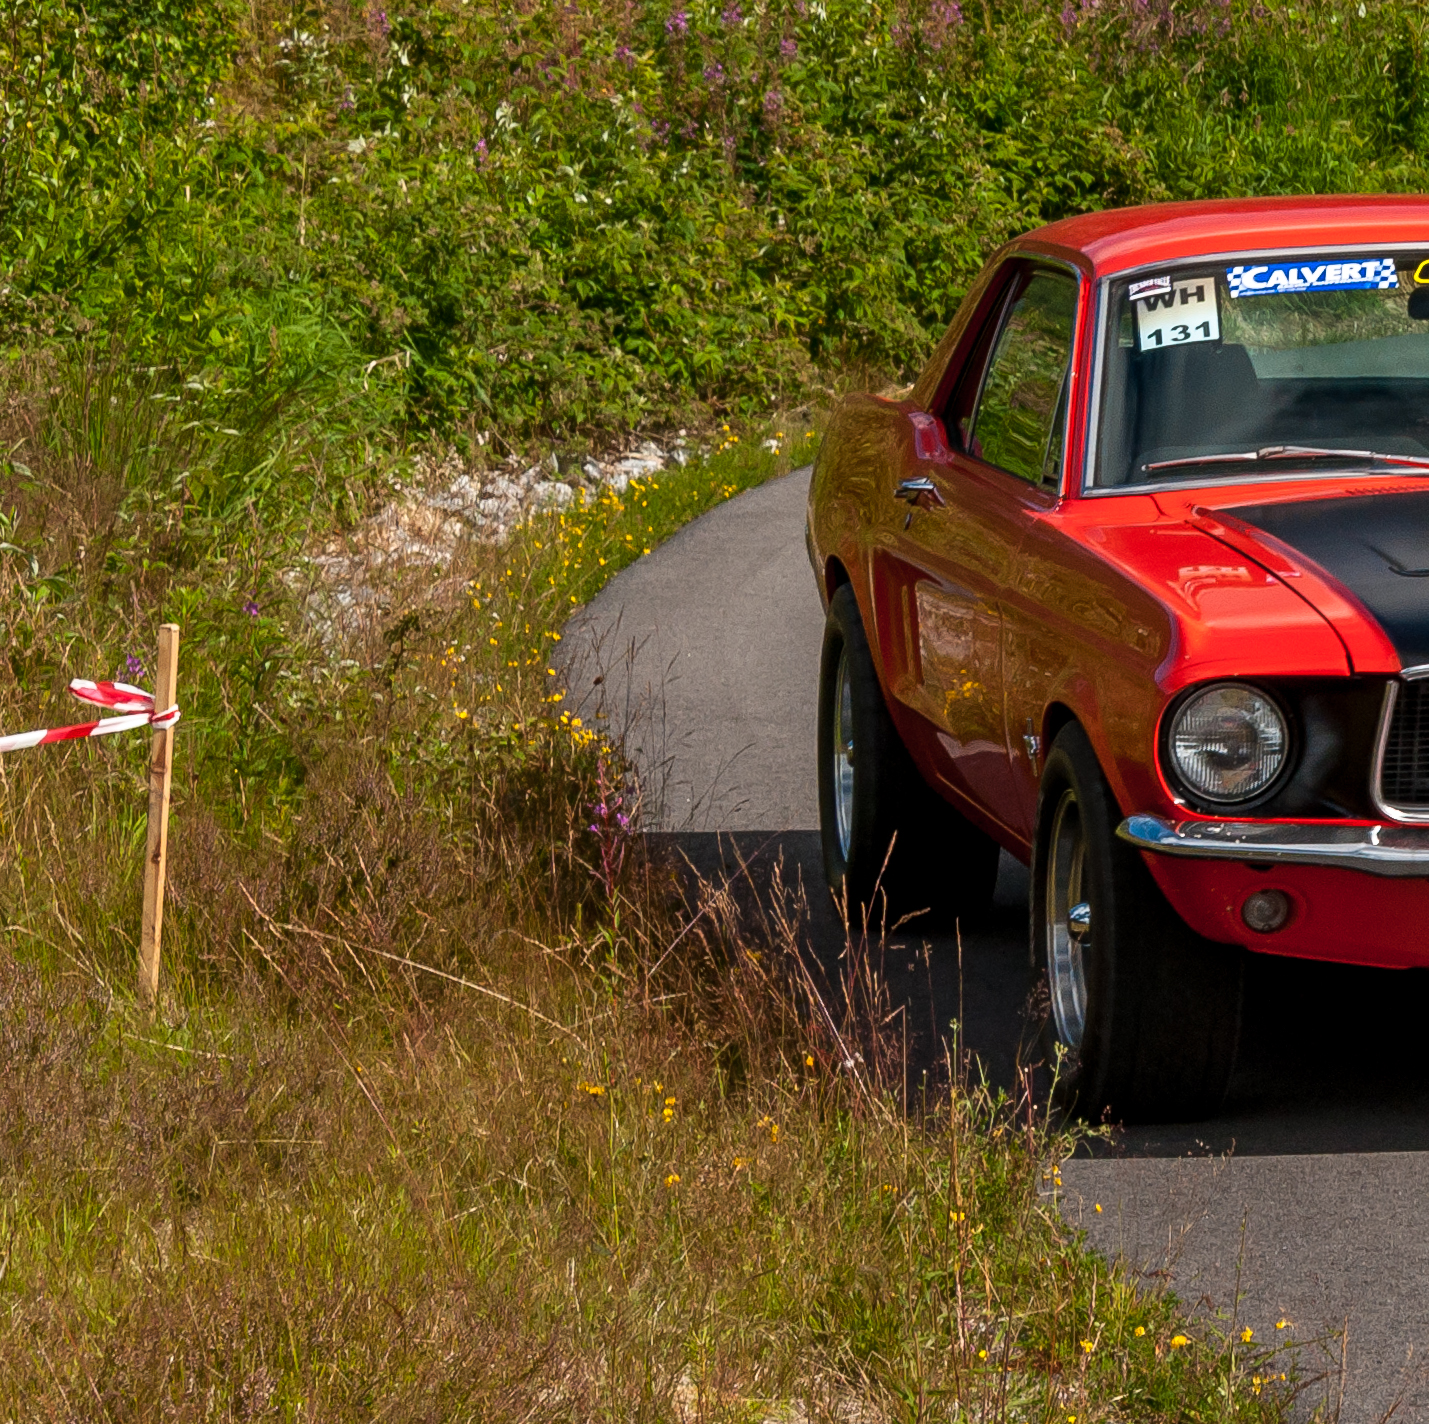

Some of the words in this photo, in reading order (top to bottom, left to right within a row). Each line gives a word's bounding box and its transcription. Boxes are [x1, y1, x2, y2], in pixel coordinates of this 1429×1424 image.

[1241, 261, 1381, 289] CALVERT
[1143, 285, 1205, 312] WH
[1147, 321, 1210, 346] 131
